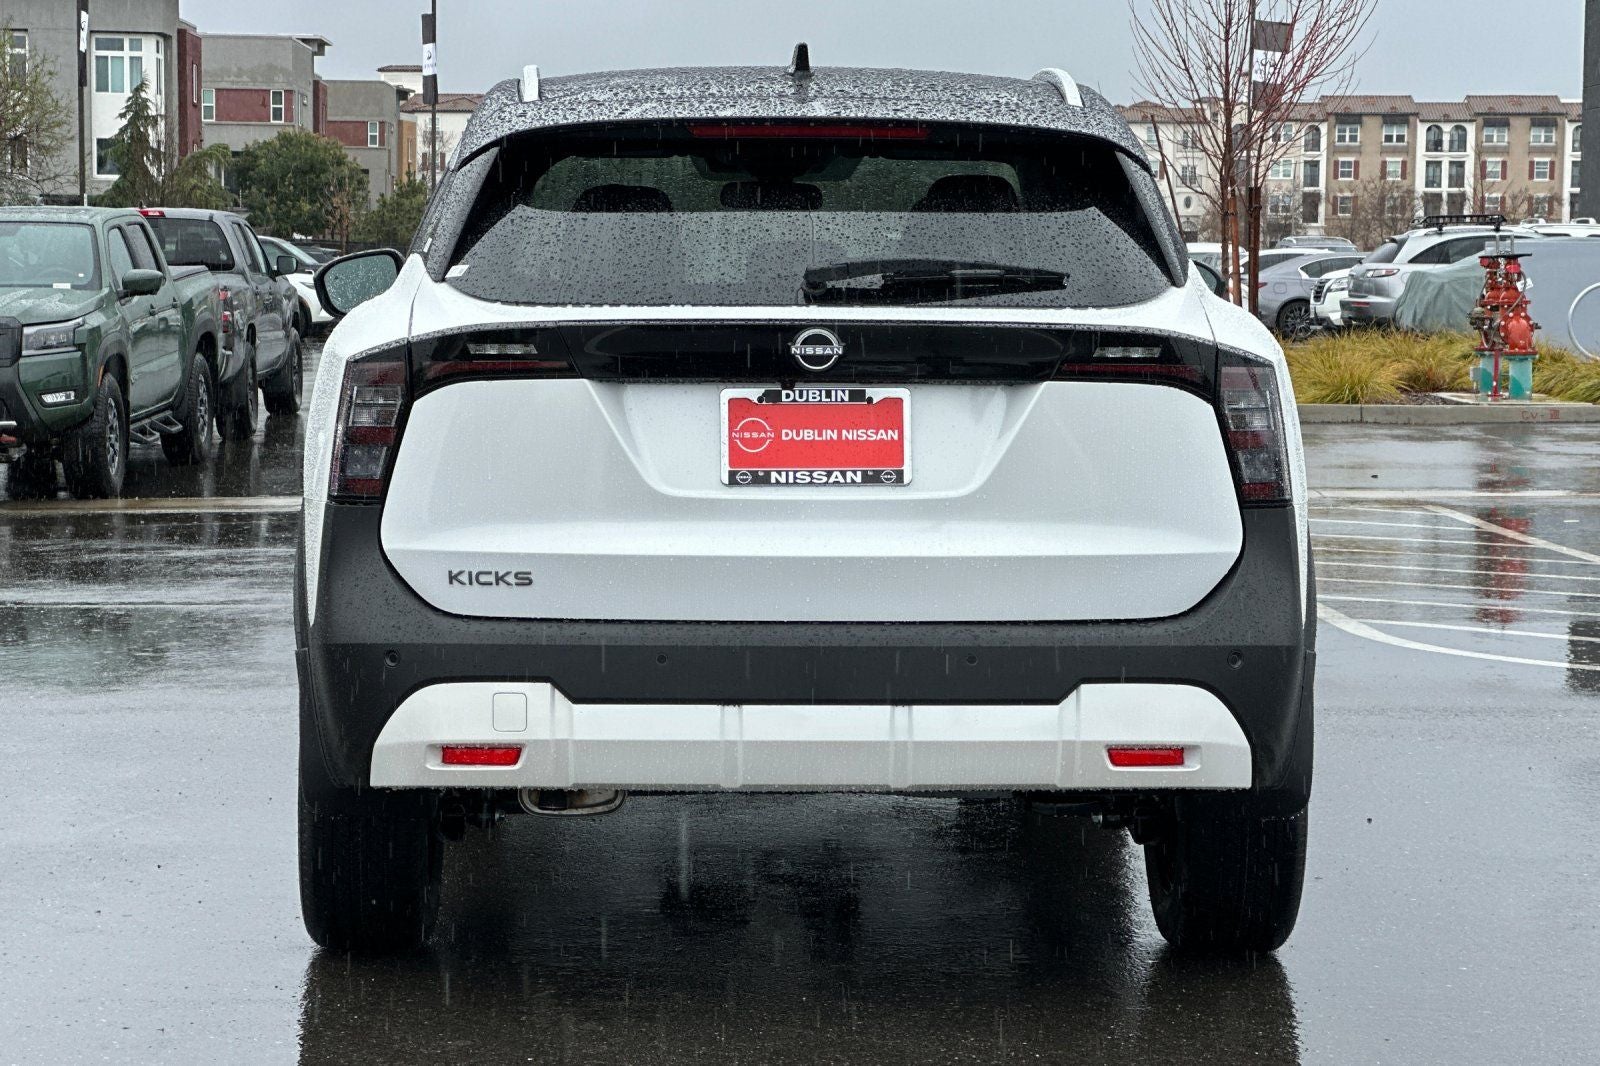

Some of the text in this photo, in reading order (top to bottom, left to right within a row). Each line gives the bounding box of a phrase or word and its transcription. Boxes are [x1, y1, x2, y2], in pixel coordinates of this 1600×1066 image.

[791, 345, 843, 355] NISSAN
[781, 389, 849, 402] DUBLIN
[732, 431, 774, 439] NISSAN
[781, 429, 898, 440] DUBLIN NISSAN
[770, 471, 862, 484] NISSAN
[448, 570, 534, 586] KICKS
